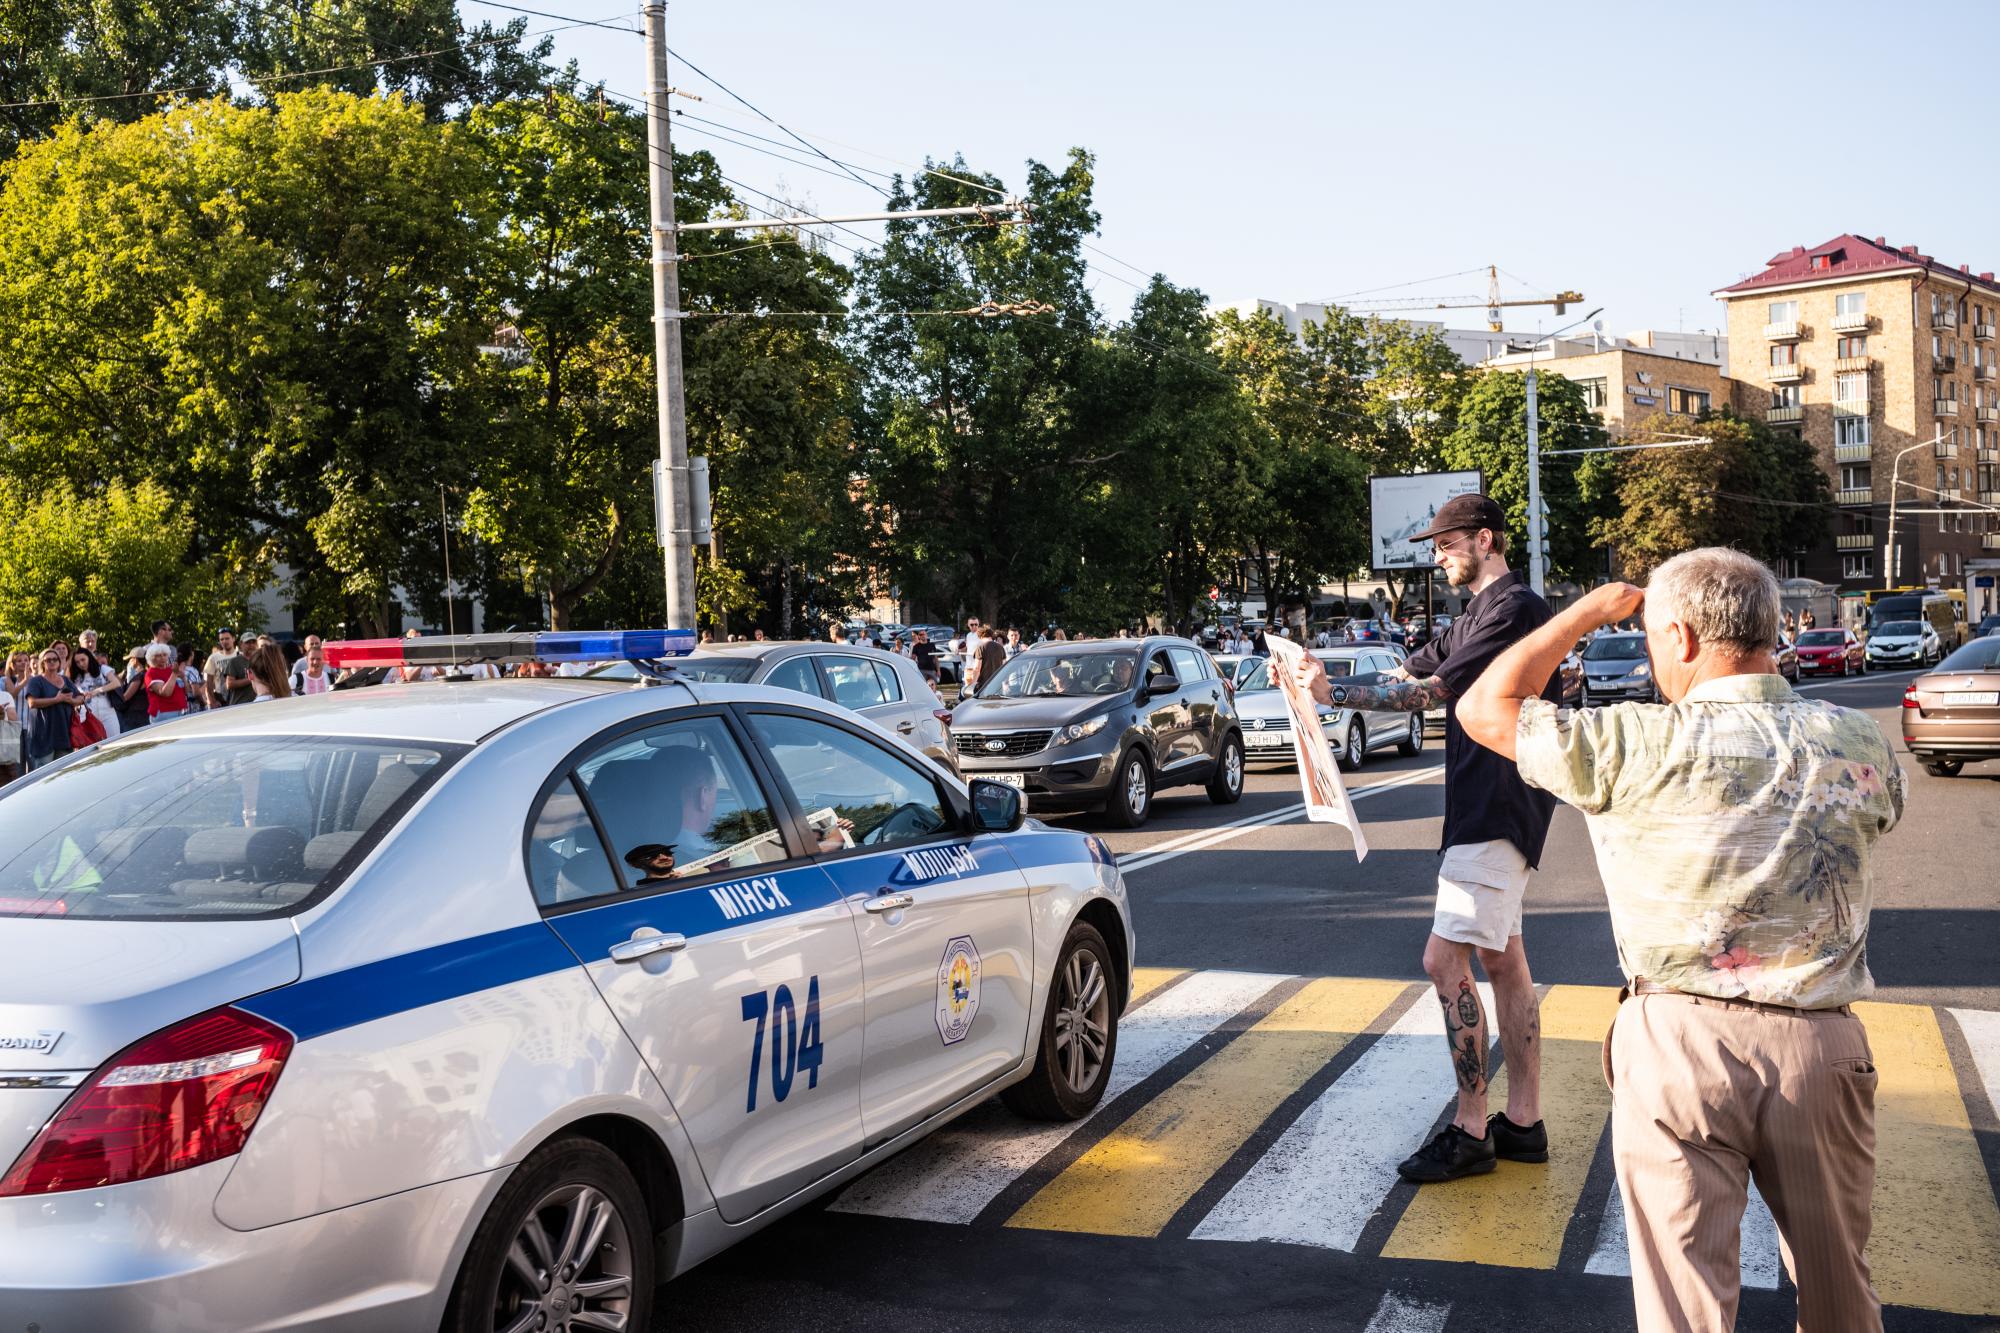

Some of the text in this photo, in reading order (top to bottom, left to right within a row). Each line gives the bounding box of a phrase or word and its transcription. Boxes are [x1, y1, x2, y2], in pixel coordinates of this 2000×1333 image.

[901, 845, 980, 880] МІЛІЦЫЯ
[708, 877, 792, 920] МІНСК
[741, 975, 824, 1113] 704
